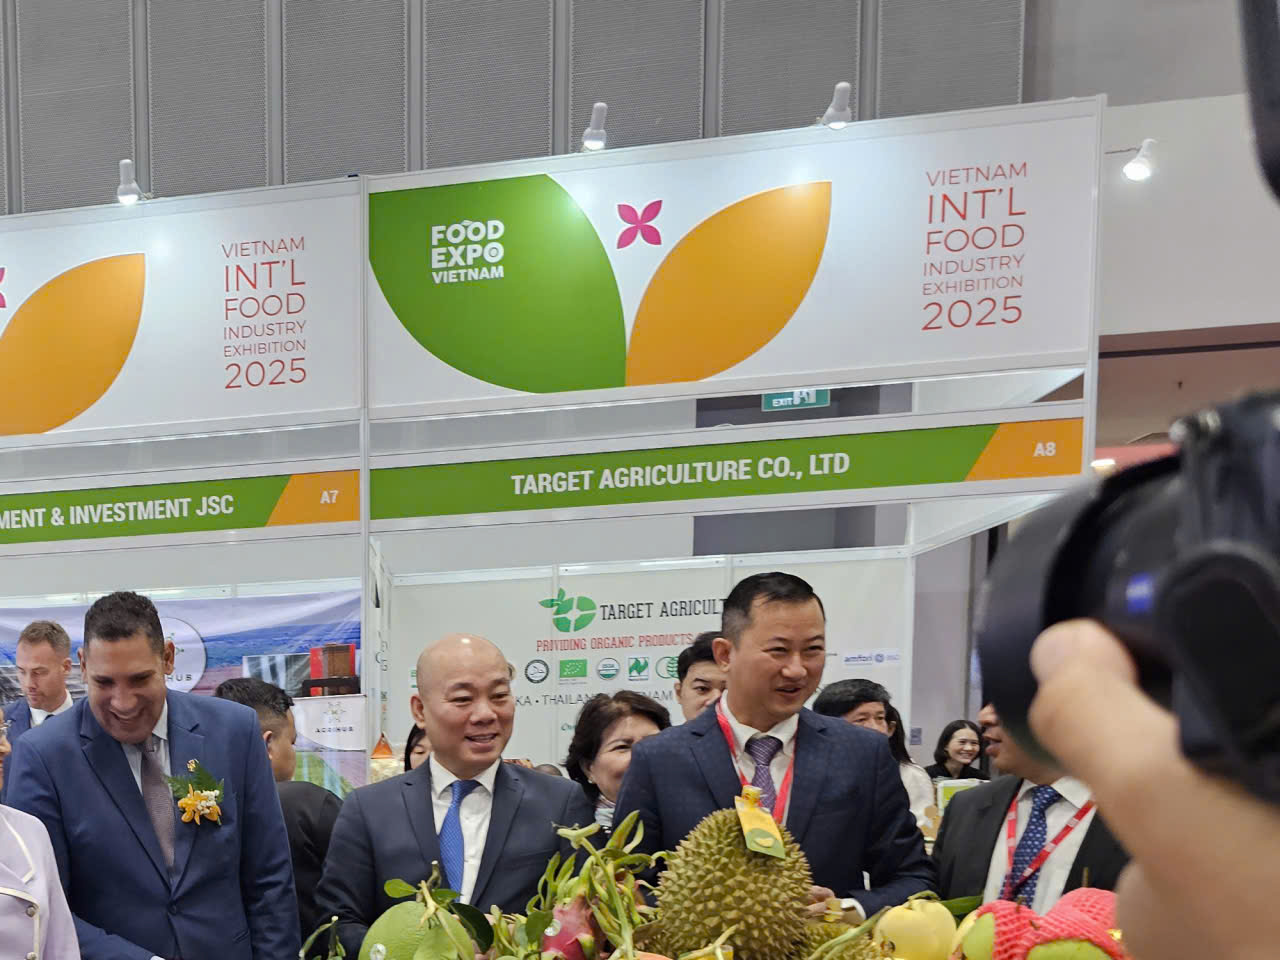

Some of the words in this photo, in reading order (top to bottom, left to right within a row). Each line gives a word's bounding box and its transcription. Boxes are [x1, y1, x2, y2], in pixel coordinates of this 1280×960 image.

[926, 162, 1027, 186] VIETNAM
[928, 187, 1026, 224] INT'L
[432, 220, 505, 245] FOOD
[926, 224, 1024, 255] FOOD
[221, 236, 305, 258] VIETNAM
[432, 241, 505, 268] EXPO
[225, 259, 306, 292] INT'L
[431, 265, 504, 284] VIETNAM
[923, 254, 1025, 276] INDUSTRY
[922, 275, 1024, 296] EXHIBITION
[225, 293, 305, 320] FOOD
[921, 295, 1022, 331] 2025
[223, 320, 307, 340] INDUSTRY
[224, 339, 306, 358] EXHIBITION
[225, 358, 307, 389] 2025
[1033, 441, 1056, 457] A8
[511, 470, 594, 495] TARGET
[599, 459, 752, 489] AGRICULTURE
[757, 456, 803, 481] CO.,
[809, 452, 850, 476] LTD
[320, 490, 339, 504] A7
[51, 507, 64, 526] &
[70, 497, 192, 525] INVESTMENT
[196, 495, 234, 516] JSC
[600, 602, 654, 620] TARGET
[536, 638, 586, 652] PROVIDING
[591, 636, 634, 650] ORGANIC
[638, 633, 694, 647] PRODUCTS
[542, 693, 595, 705] THAILAN
